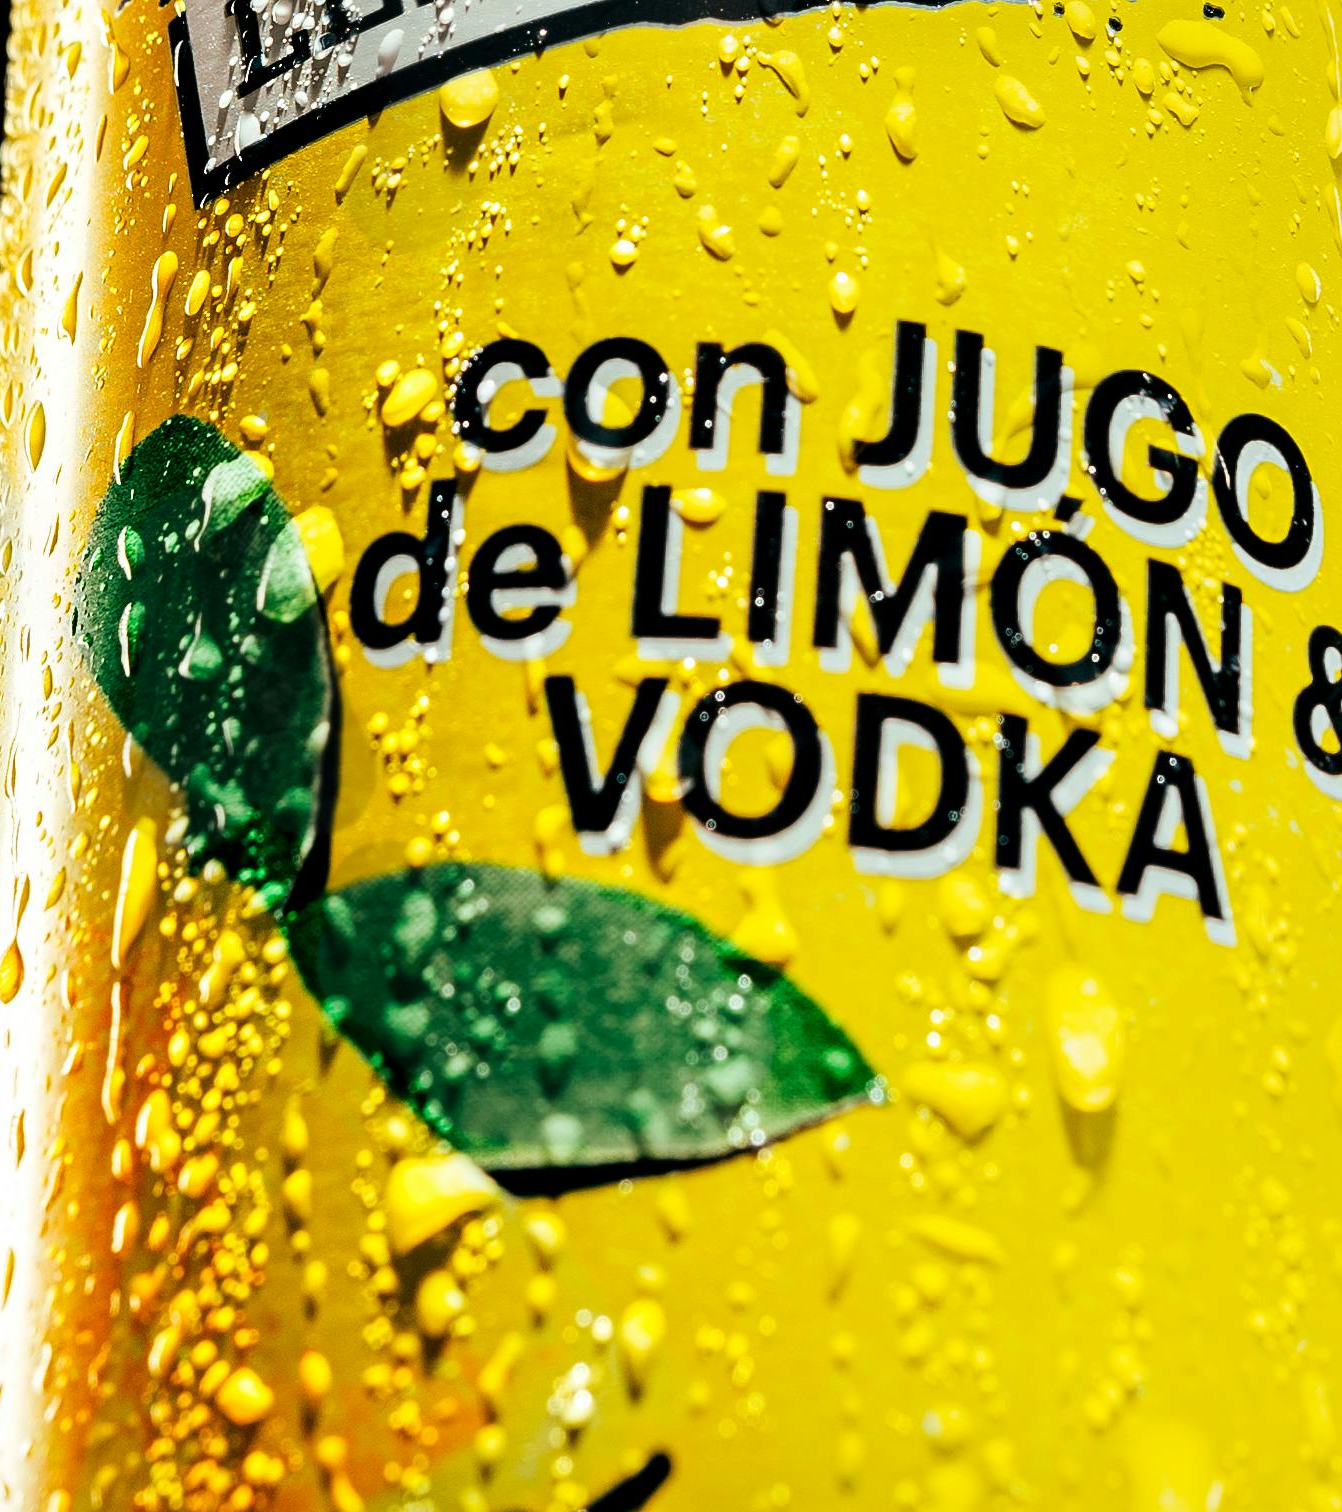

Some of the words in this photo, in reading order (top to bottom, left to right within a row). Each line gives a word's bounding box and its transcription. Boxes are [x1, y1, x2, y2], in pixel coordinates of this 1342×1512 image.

[458, 335, 790, 458] con
[856, 320, 1318, 574] JUGO
[349, 479, 571, 652] de
[632, 485, 1243, 738] LIMÓN
[544, 673, 1226, 922] VODKA
